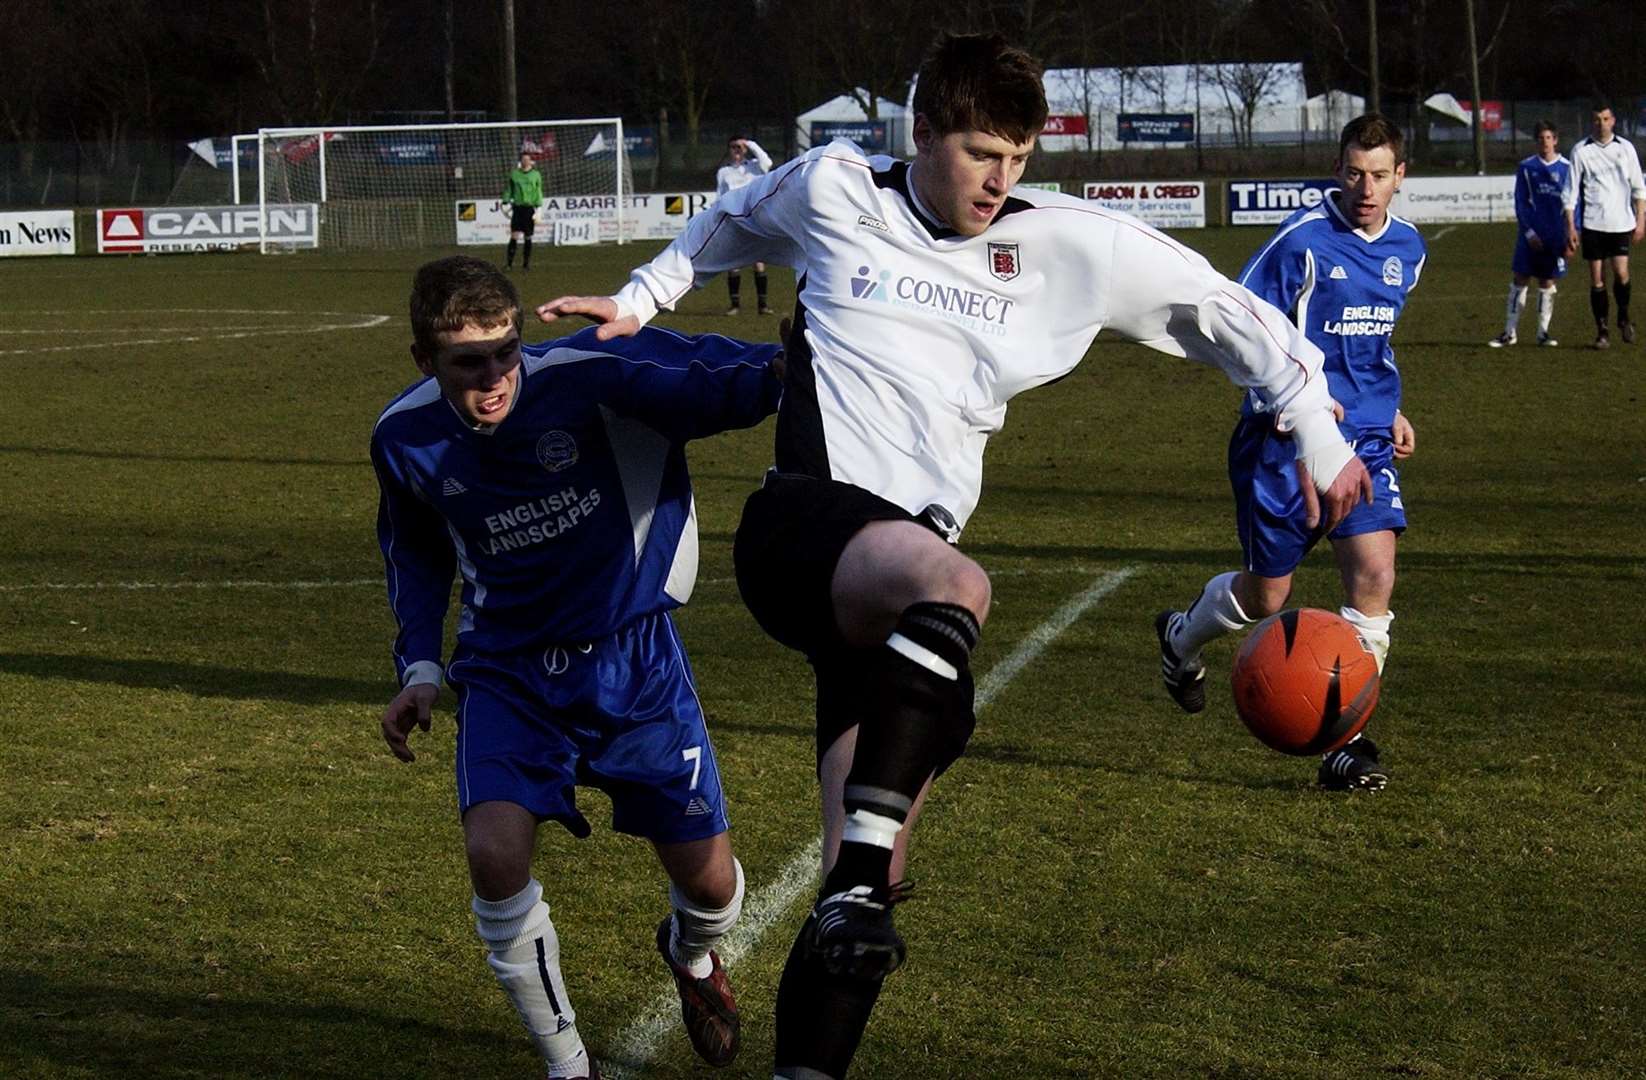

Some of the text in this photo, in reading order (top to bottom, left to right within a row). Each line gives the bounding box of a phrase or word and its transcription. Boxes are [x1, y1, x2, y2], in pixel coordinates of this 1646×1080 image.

[1087, 184, 1200, 199] EASON & CREED
[1408, 192, 1459, 204] Consulting
[17, 221, 72, 244] News
[148, 209, 308, 236] CAIRN
[896, 276, 1014, 325] CONNECT
[1342, 305, 1395, 322] ENGLISH
[478, 487, 601, 556] LANDSCAPES
[484, 485, 579, 535] ENGLISH
[682, 746, 702, 791] 7
